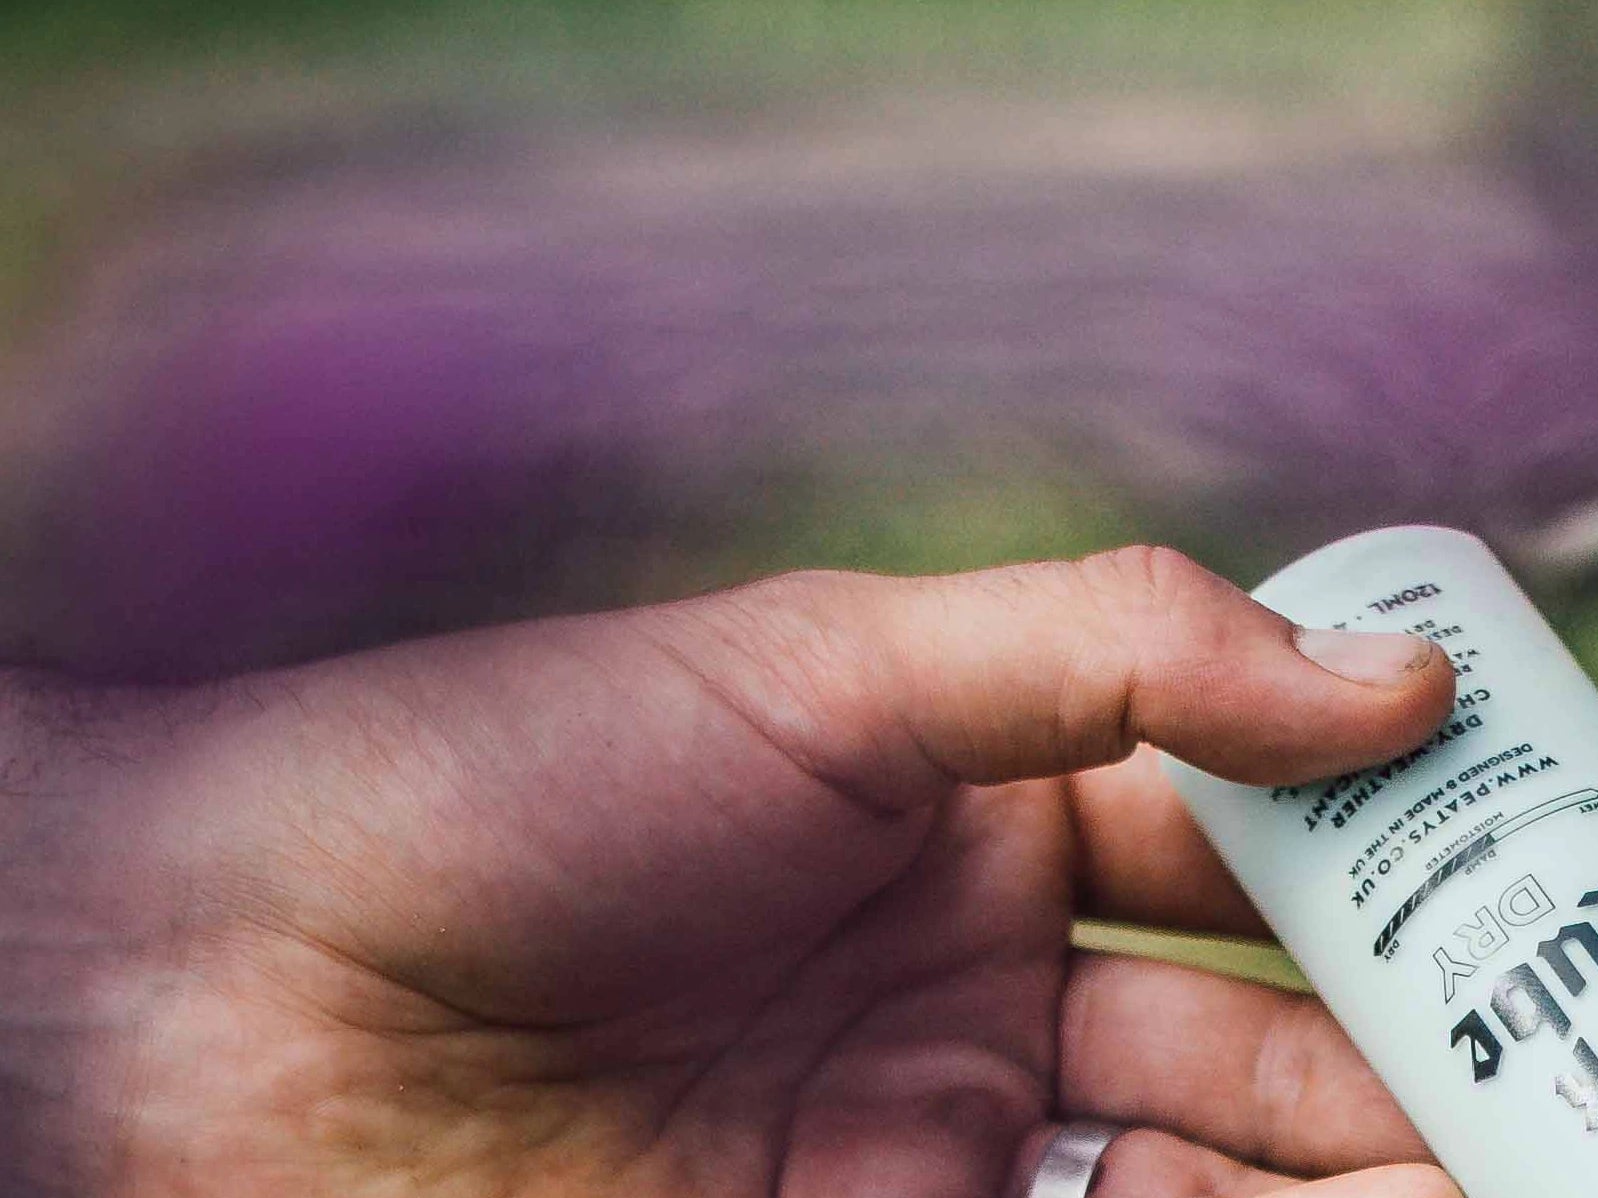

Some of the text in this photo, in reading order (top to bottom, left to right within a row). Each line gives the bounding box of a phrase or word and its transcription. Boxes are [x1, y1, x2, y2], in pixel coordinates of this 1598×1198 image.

[1368, 582, 1443, 614] 120ML
[1348, 742, 1534, 879] DESIGNED & MADE IN THE UK
[1350, 756, 1560, 910] WWW.PEATYS.CO.UK
[1424, 811, 1506, 873] MOISTOMETER
[1463, 849, 1498, 877] DAMP
[1384, 938, 1401, 964] DRY
[1432, 873, 1556, 1005] DRY
